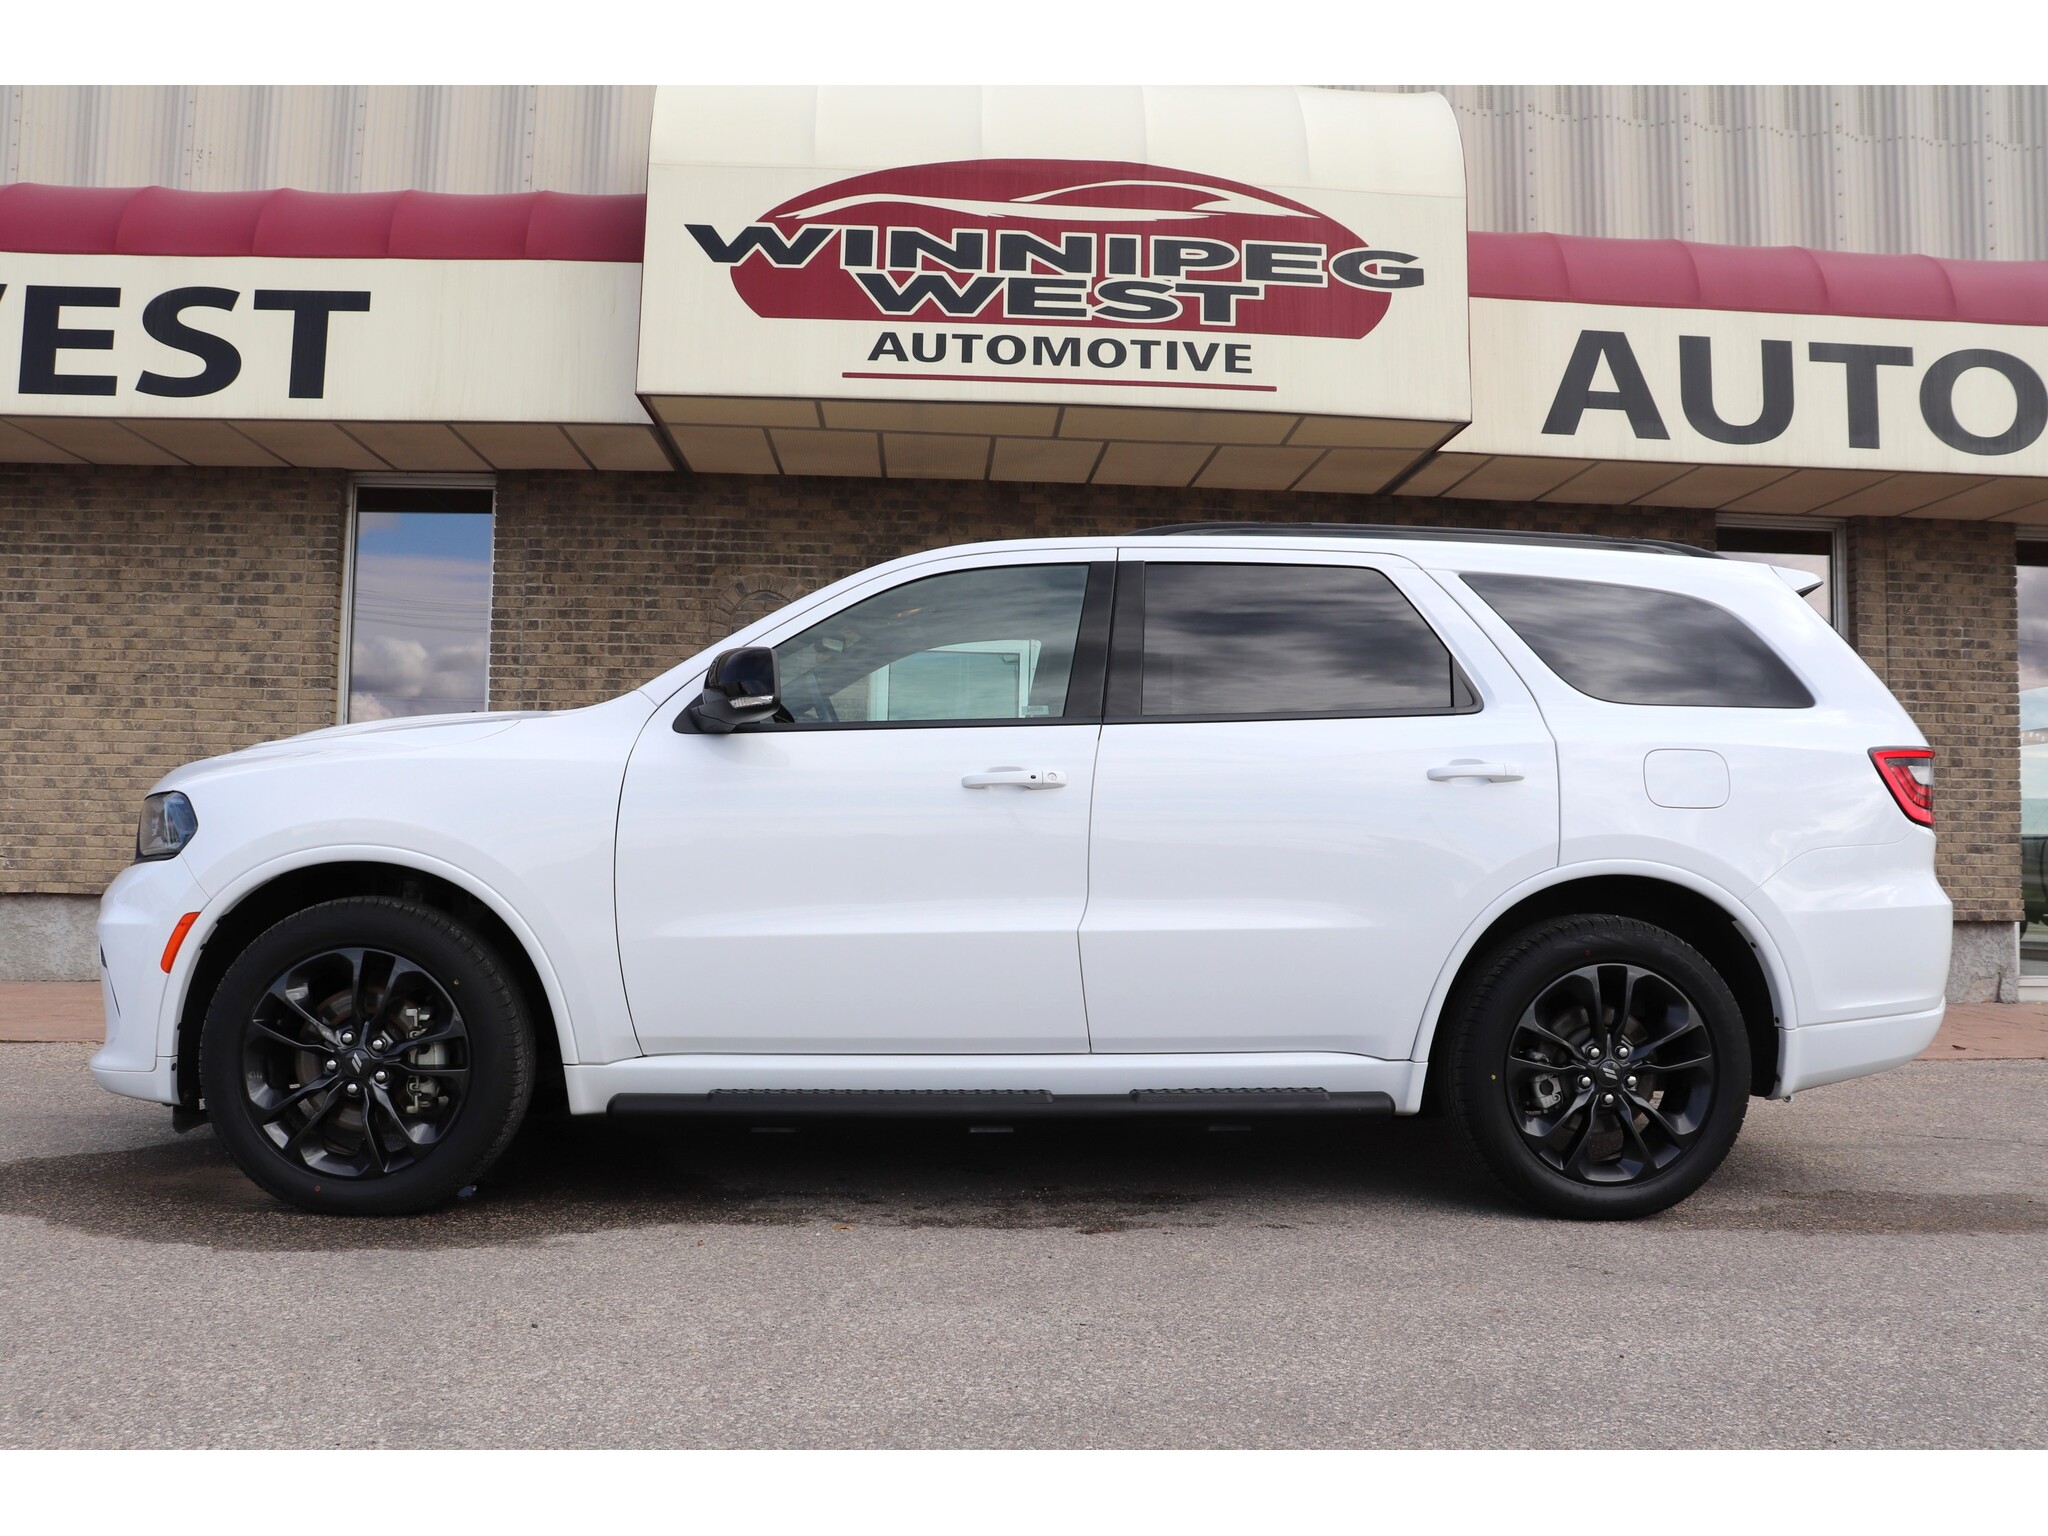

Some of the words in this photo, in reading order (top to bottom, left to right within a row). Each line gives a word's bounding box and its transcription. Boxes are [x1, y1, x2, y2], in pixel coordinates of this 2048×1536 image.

[684, 224, 1424, 290] WINNIPEG
[857, 273, 1261, 326] WEST
[0, 283, 371, 399] EST
[867, 332, 1253, 374] AUTOMOTIVE
[1541, 329, 2048, 456] AUTO
